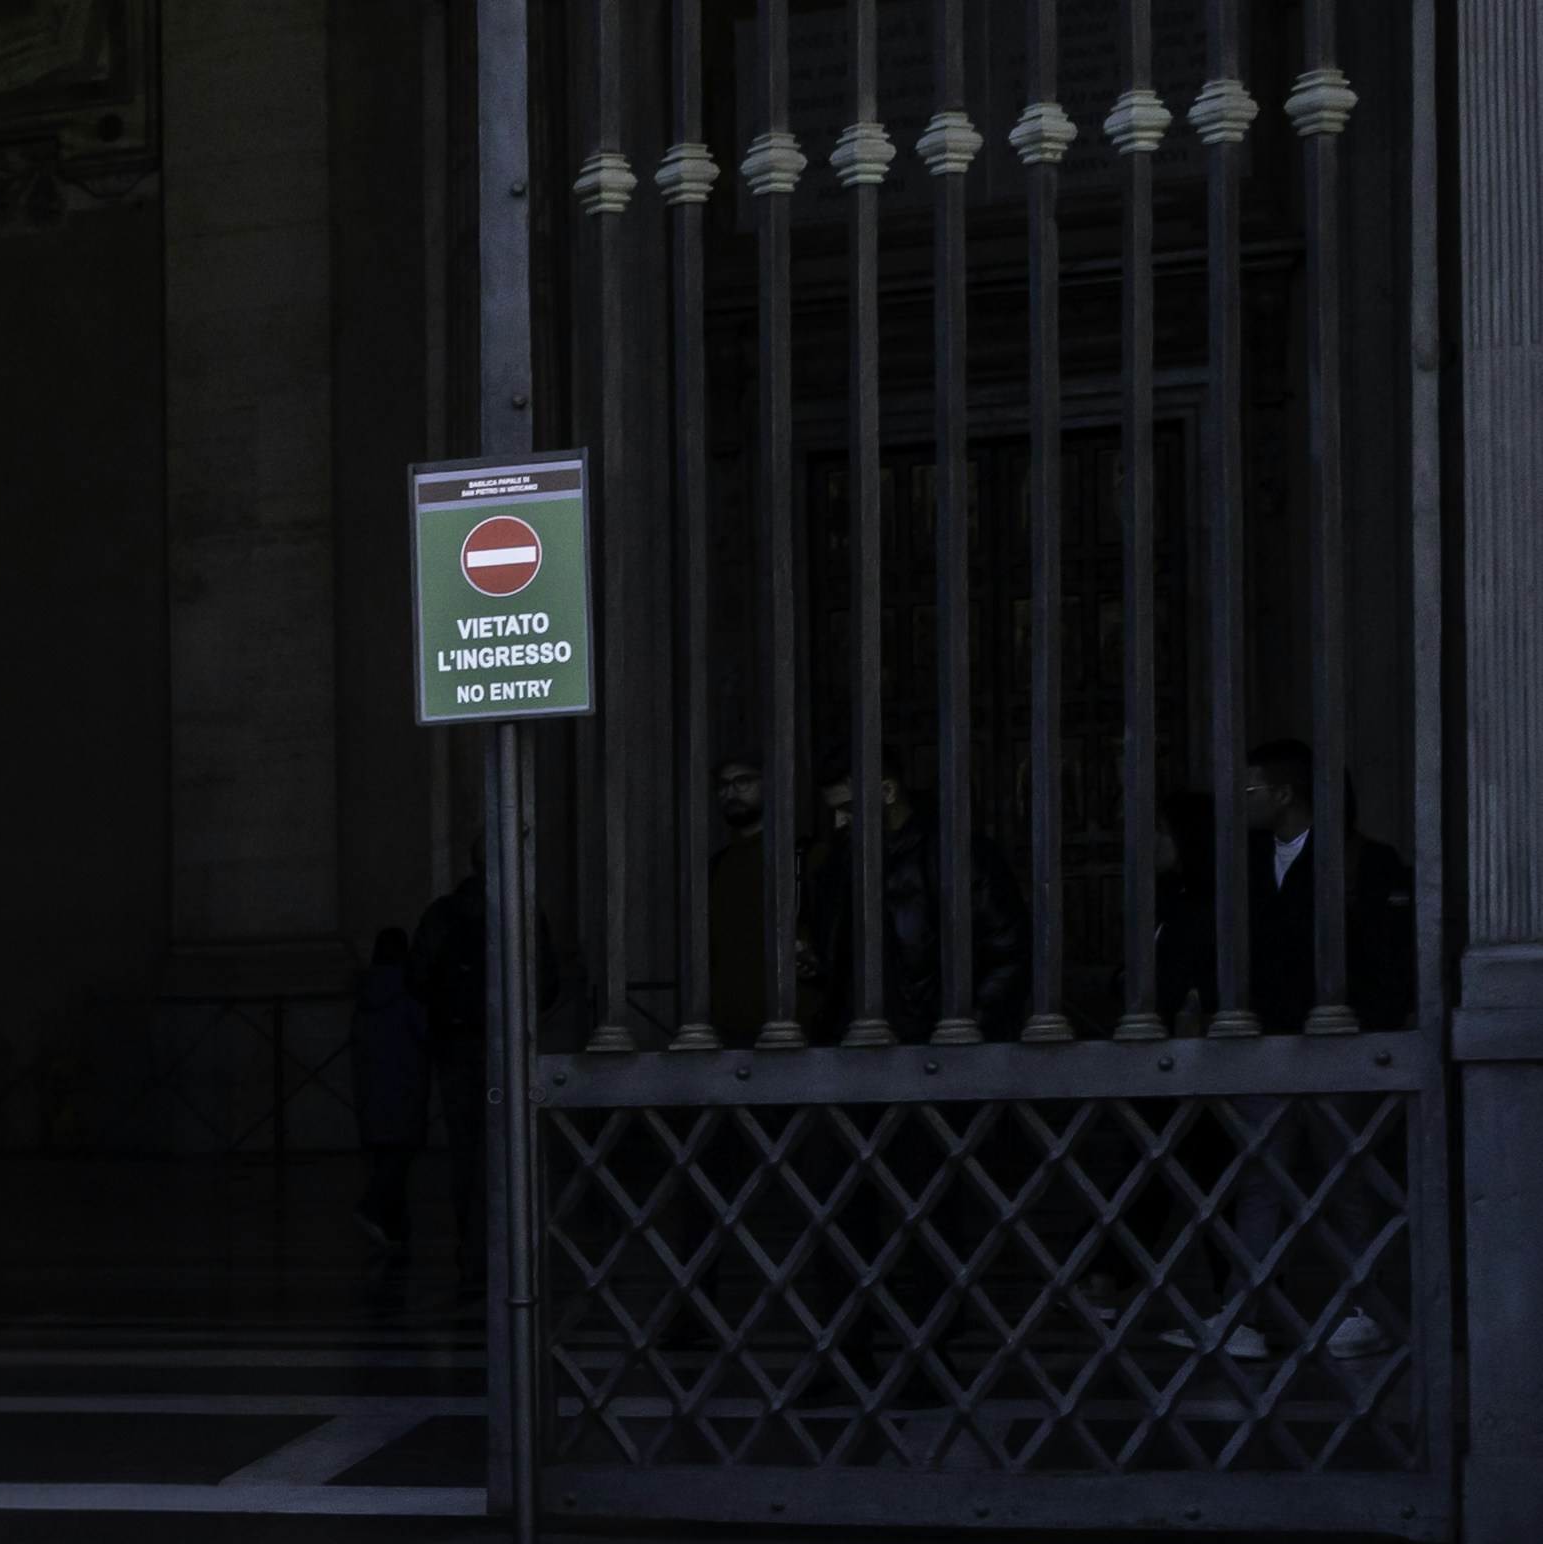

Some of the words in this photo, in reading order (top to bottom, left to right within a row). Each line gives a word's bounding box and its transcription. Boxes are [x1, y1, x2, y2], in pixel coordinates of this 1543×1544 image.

[457, 613, 549, 639] VIETATO
[438, 641, 571, 671] L'INGRESSO
[457, 685, 484, 703] NO
[490, 679, 552, 700] ENTRY
